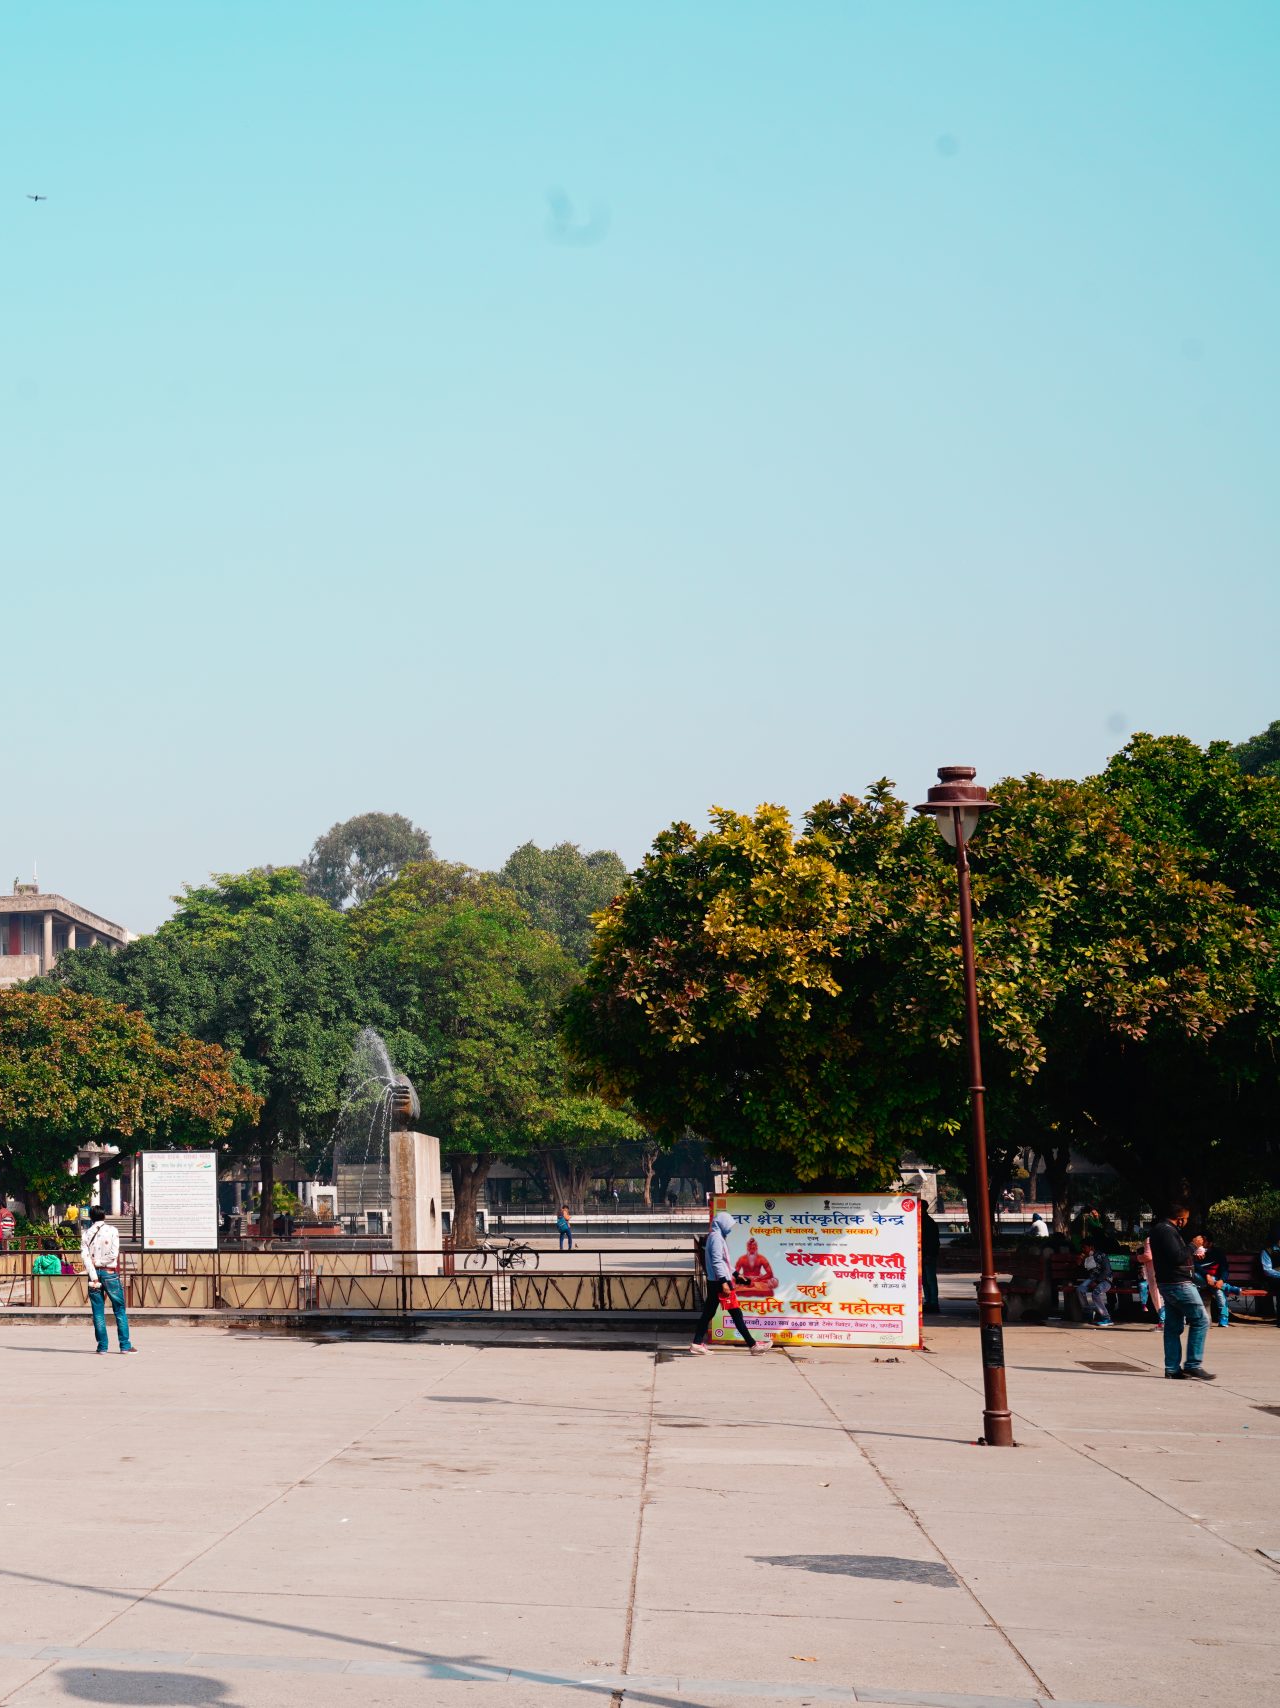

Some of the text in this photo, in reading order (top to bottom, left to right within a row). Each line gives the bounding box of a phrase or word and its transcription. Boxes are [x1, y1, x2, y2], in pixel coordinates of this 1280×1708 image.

[757, 1211, 784, 1225] क्षेत्र
[790, 1211, 865, 1226] सांस्कृतिक
[872, 1212, 905, 1226] केन्द्र
[785, 1249, 907, 1268] संस्कार भारती
[879, 1269, 907, 1280] इकाई
[797, 1282, 827, 1298] चतुर्थ
[739, 1297, 905, 1316] तमुनि नाट्य महोत्सव
